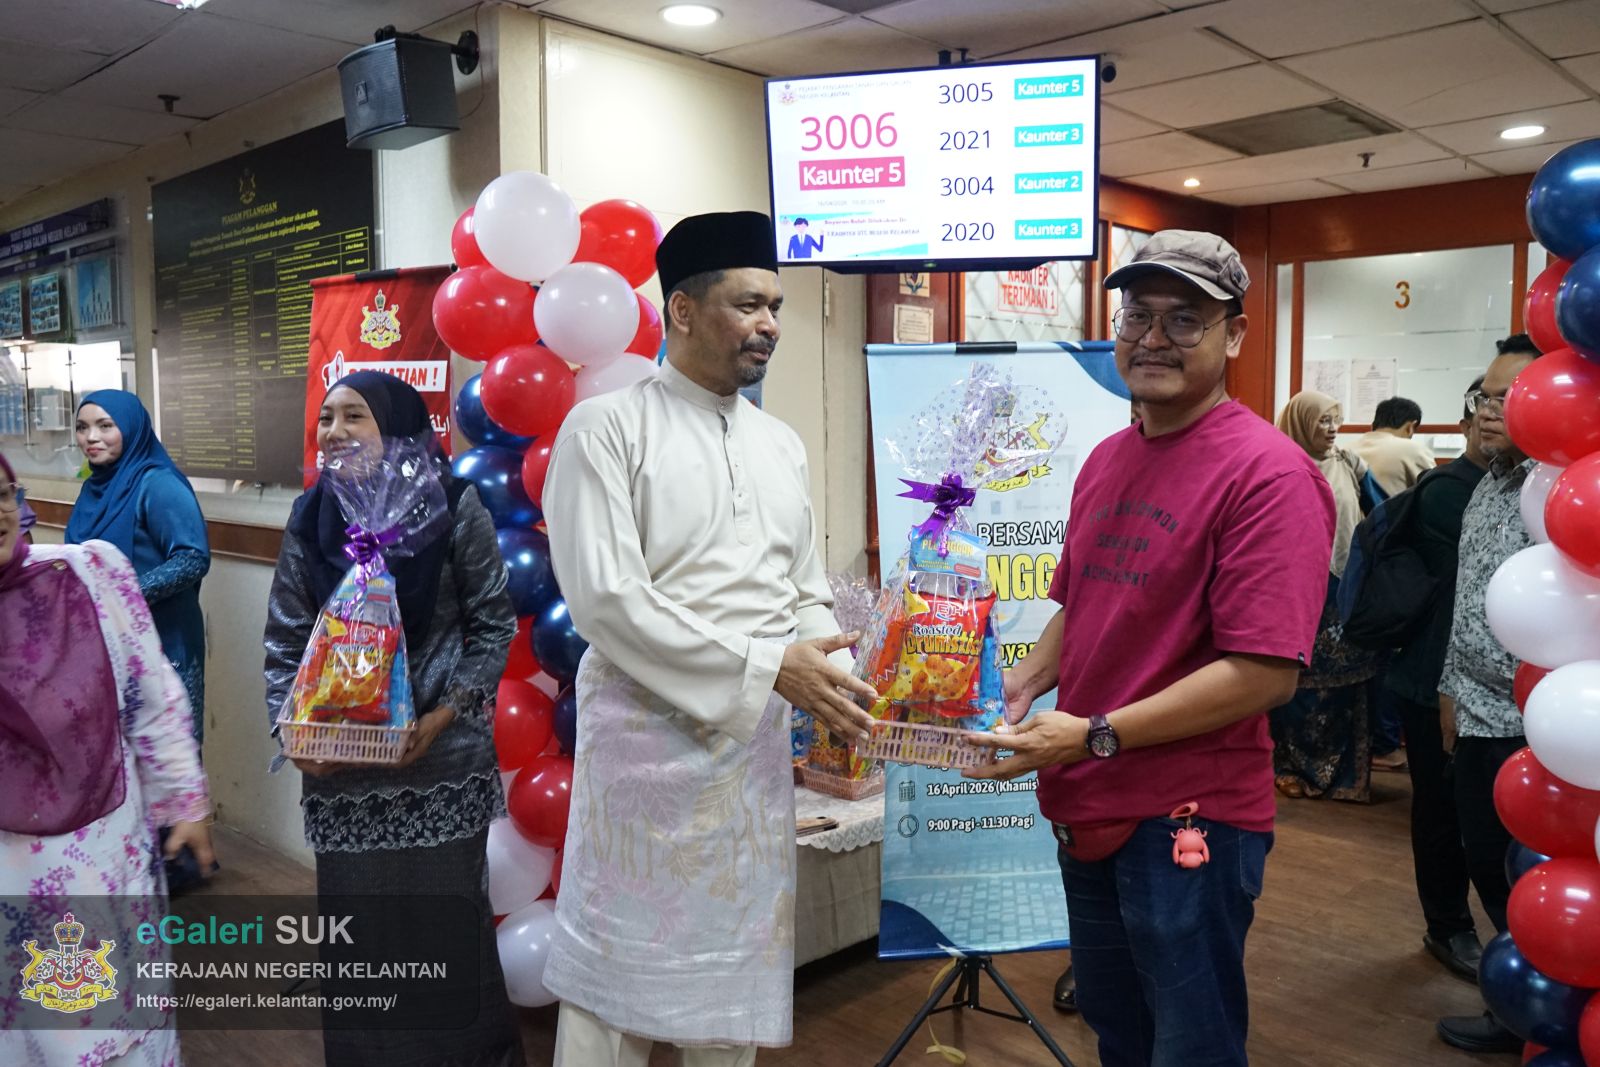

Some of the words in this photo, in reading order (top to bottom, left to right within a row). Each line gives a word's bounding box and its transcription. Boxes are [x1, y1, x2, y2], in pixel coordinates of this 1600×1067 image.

[939, 82, 994, 104] 3005
[1018, 78, 1070, 96] Kaunter
[1072, 79, 1080, 93] 5
[800, 112, 898, 152] 3006
[939, 130, 991, 151] 2021
[1018, 127, 1070, 144] Kaunter
[1071, 128, 1080, 141] 3
[803, 161, 882, 186] Kaunter
[888, 161, 902, 183] 5
[1018, 175, 1069, 191] Kaunter
[1070, 175, 1079, 188] 2
[940, 176, 995, 197] 3004
[941, 222, 995, 242] 2020
[1018, 222, 1069, 238] Kaunter
[1070, 222, 1079, 235] 3
[1008, 266, 1049, 286] KAUNTER
[1002, 284, 1048, 309] TERIMAAN
[1051, 290, 1055, 309] 1
[1395, 281, 1411, 309] 3
[977, 520, 1069, 546] BERSAM
[986, 552, 1057, 601] NGG
[913, 622, 963, 636] Roasted
[927, 783, 941, 796] 16
[942, 782, 968, 798] April
[969, 781, 995, 794] 2026
[928, 819, 950, 832] 9:00
[951, 818, 975, 833] Pagi
[981, 816, 1010, 829] 11.30
[1010, 814, 1034, 829] Pagi
